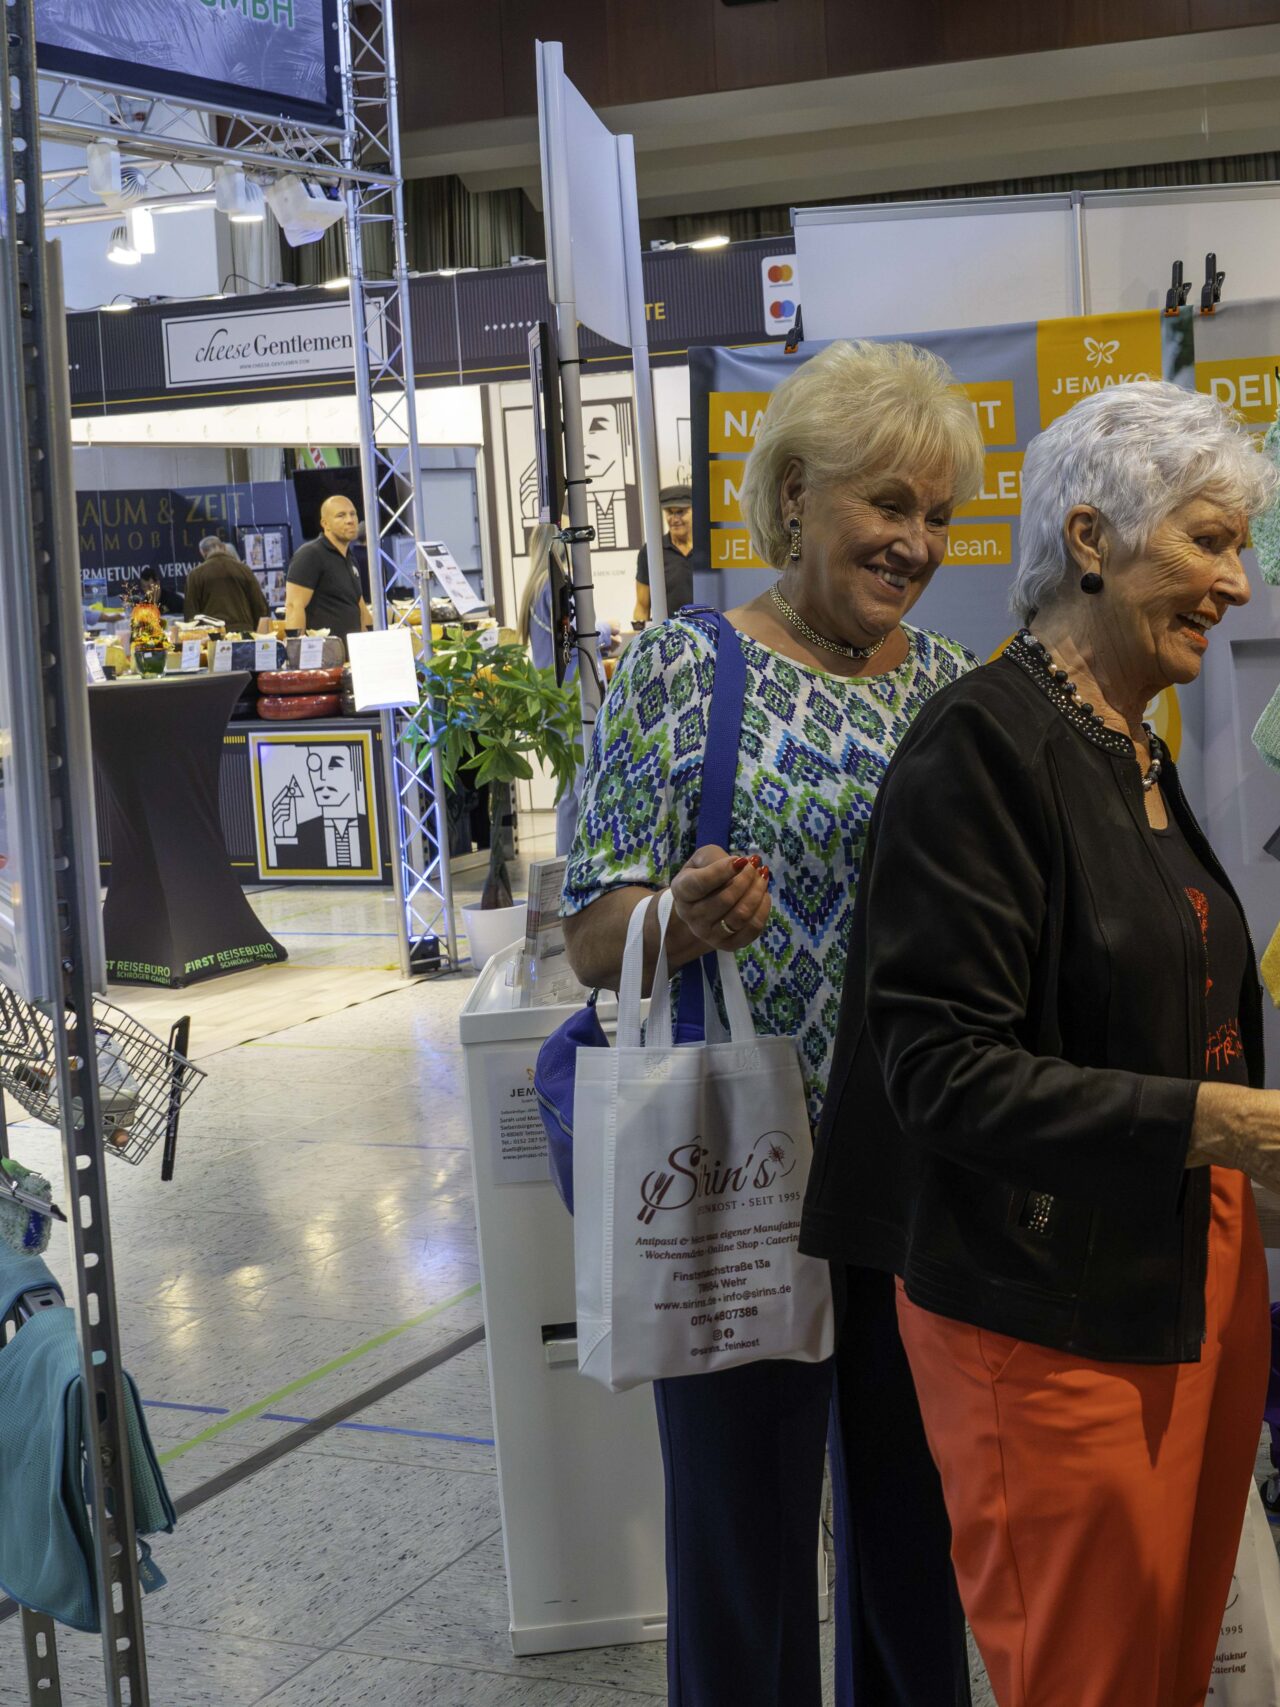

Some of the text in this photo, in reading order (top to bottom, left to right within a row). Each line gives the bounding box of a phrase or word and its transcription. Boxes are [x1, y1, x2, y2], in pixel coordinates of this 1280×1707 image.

[195, 328, 354, 363] cheese Gentlemen
[78, 498, 149, 528] AUM
[185, 942, 274, 974] FIRST REISEBÜRO
[117, 961, 171, 978] REISEBÜRO
[150, 976, 171, 985] GMBH
[749, 1196, 774, 1208] SEIT
[779, 1191, 801, 1203] 1995
[635, 1234, 678, 1247] Antipasti
[719, 1227, 752, 1242] eigener
[753, 1220, 801, 1235] Manufaktu
[736, 1239, 759, 1253] Shop
[755, 1259, 771, 1270] 13a
[720, 1276, 748, 1289] Wehr
[723, 1283, 792, 1303] info@sirins.de
